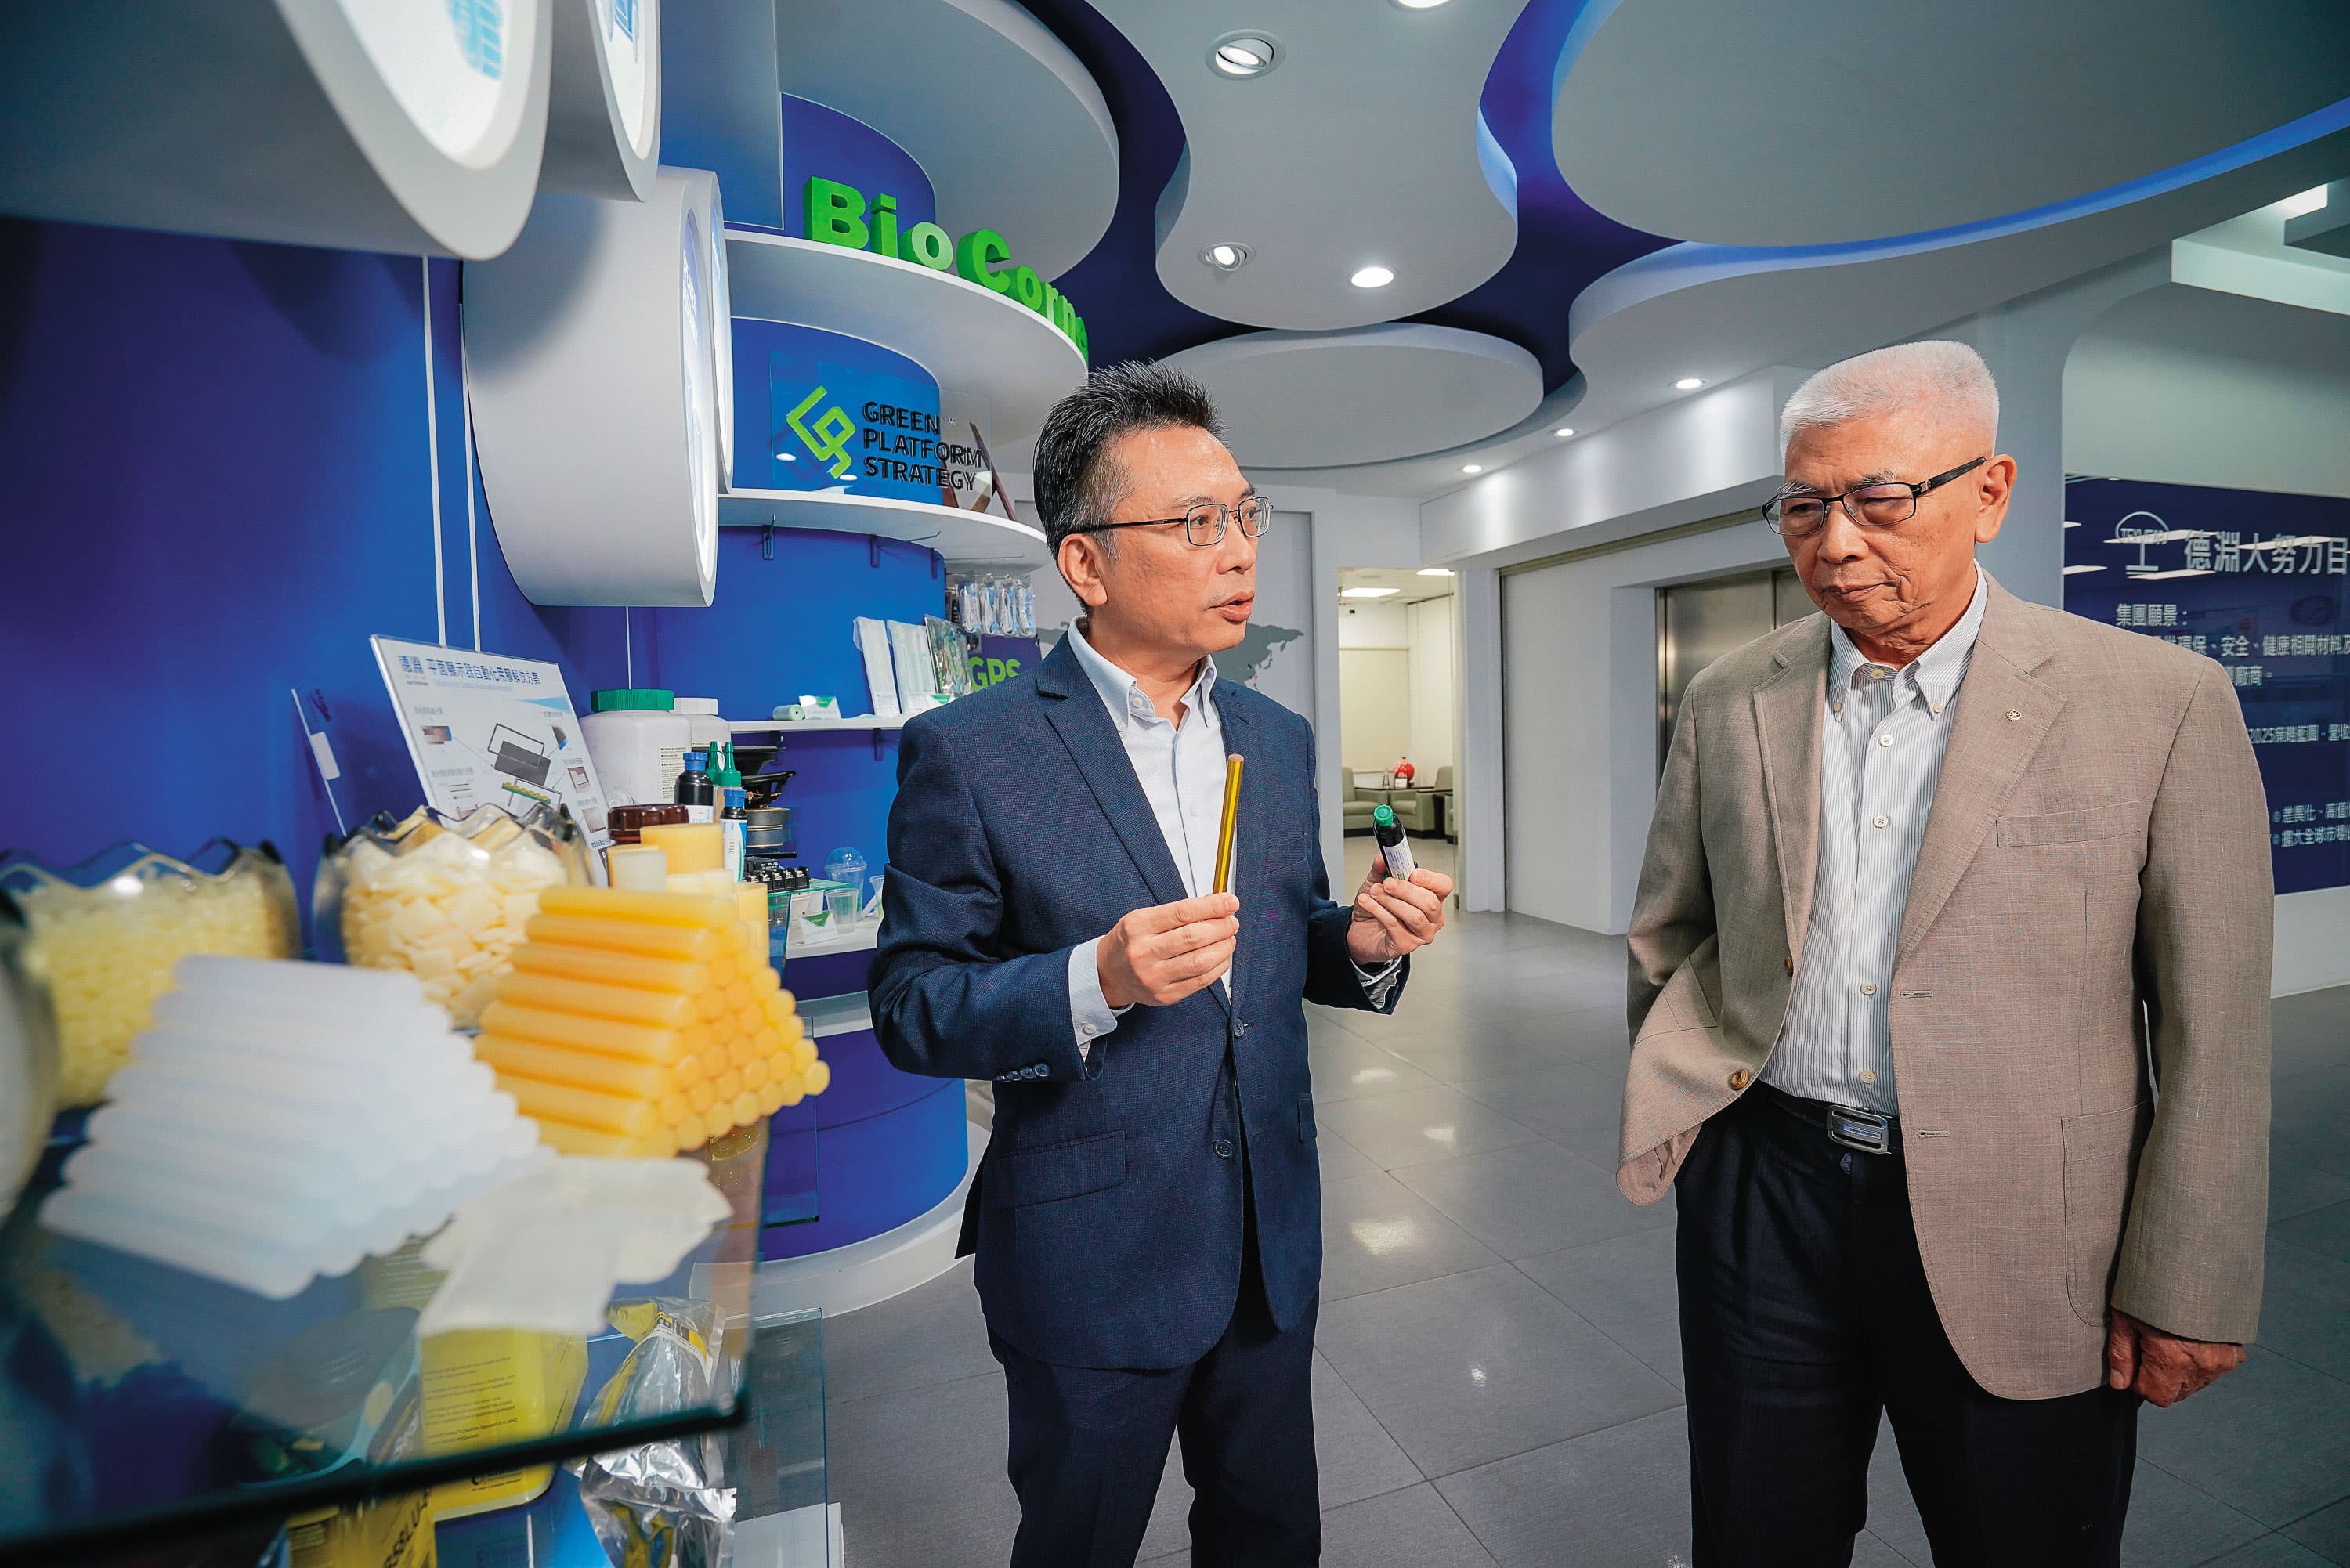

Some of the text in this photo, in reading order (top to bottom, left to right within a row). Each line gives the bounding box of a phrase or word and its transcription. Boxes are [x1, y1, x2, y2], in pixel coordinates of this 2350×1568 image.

[804, 175, 953, 271] Bio
[863, 401, 940, 435] GREEN
[863, 428, 982, 468] PLATFORM
[864, 456, 977, 491] STRATEGY
